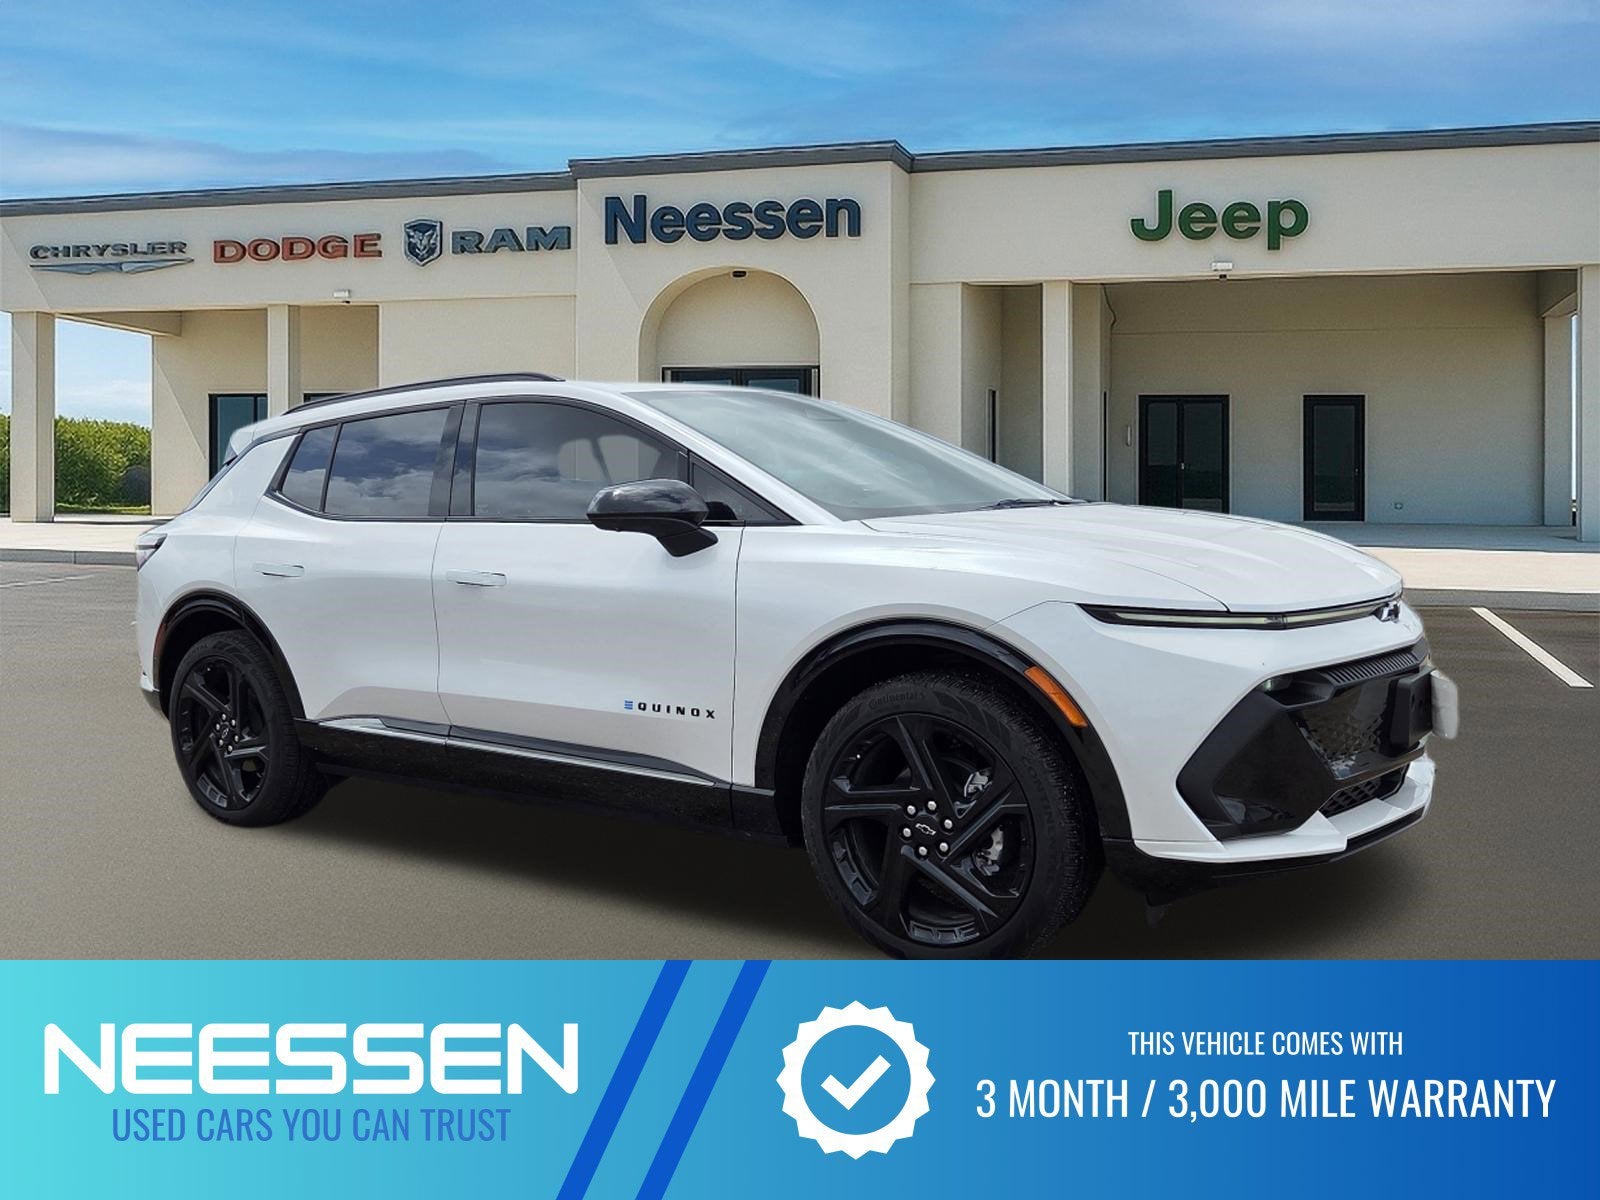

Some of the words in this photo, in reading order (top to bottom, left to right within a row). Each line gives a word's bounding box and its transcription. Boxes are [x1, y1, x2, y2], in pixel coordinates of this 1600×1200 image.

[605, 194, 862, 245] Neessen
[1130, 189, 1309, 250] Jeep
[29, 241, 188, 259] CHRYSLER
[213, 233, 382, 264] DODGE
[451, 226, 571, 255] RAM
[624, 699, 716, 720] EQUINOX
